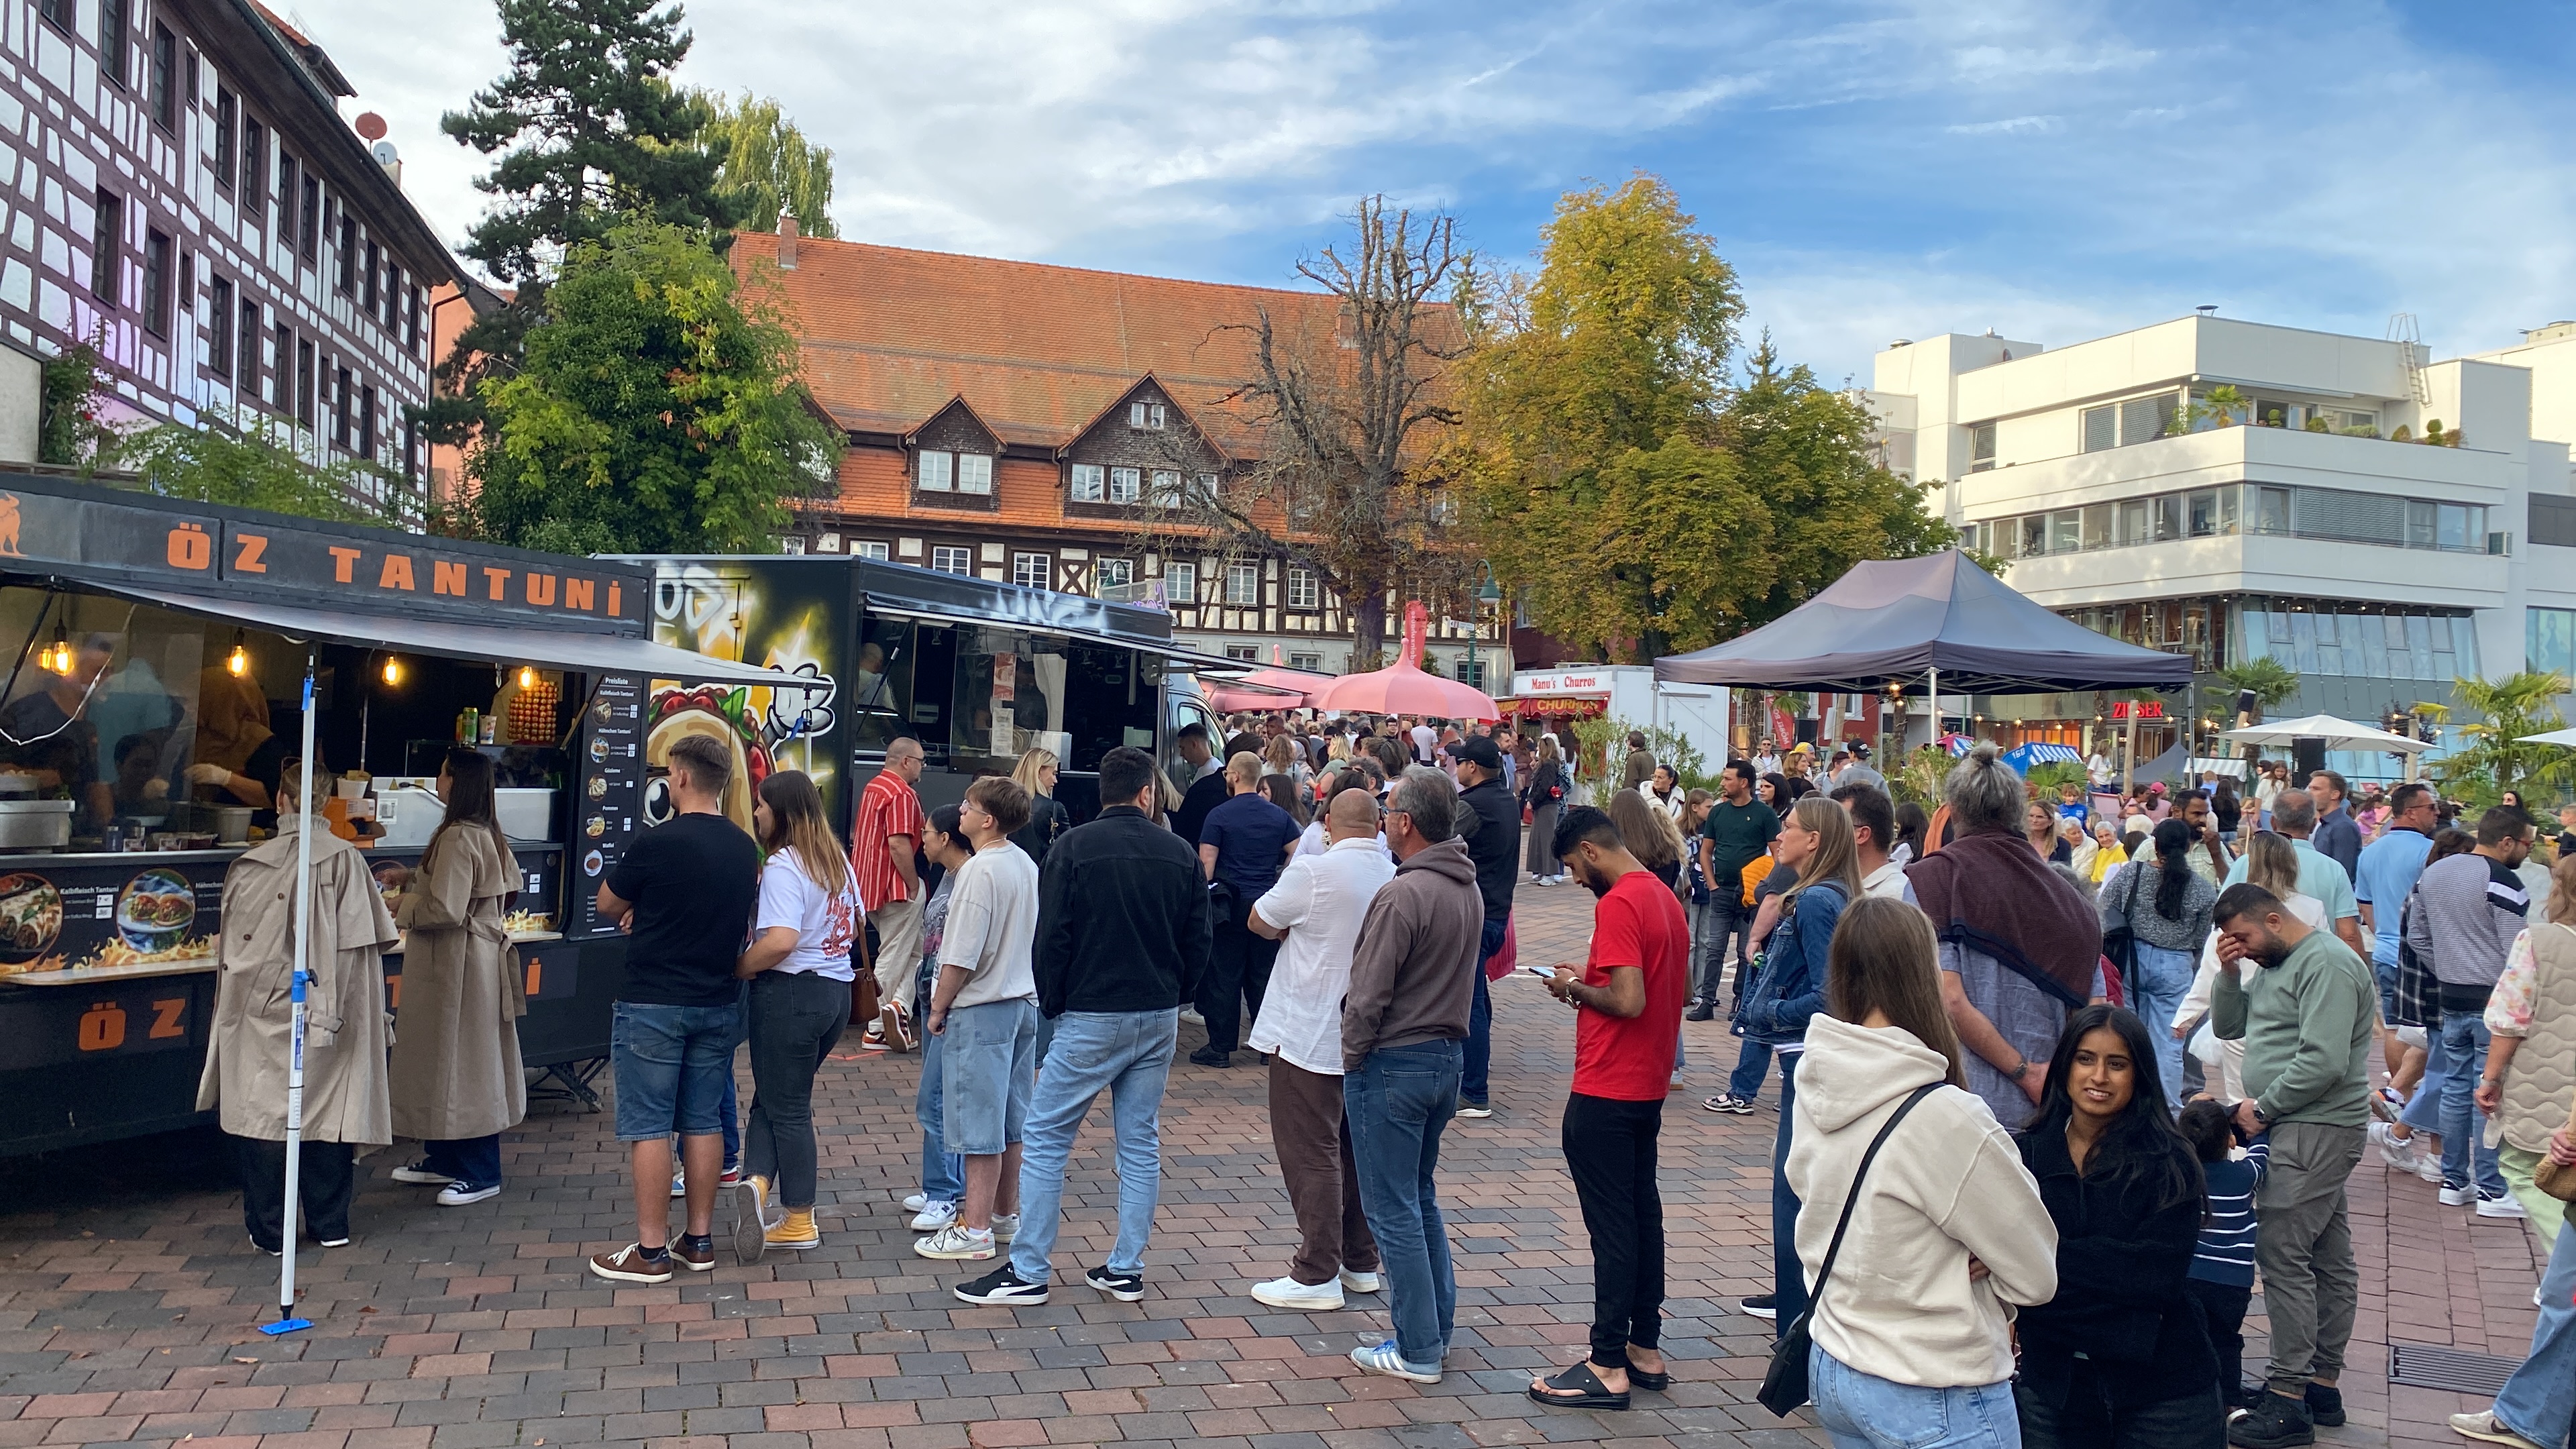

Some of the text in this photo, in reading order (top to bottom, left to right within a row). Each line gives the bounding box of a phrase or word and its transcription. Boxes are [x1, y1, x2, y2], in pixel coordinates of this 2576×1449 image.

[167, 522, 268, 574] ÖZ
[605, 677, 629, 685] Preisliste
[1532, 676, 1596, 690] Manu's Churros
[2112, 701, 2163, 718] ZISER
[2012, 747, 2026, 759] 160
[60, 887, 95, 895] Kalbfleisch
[78, 998, 186, 1051] ÖZ
